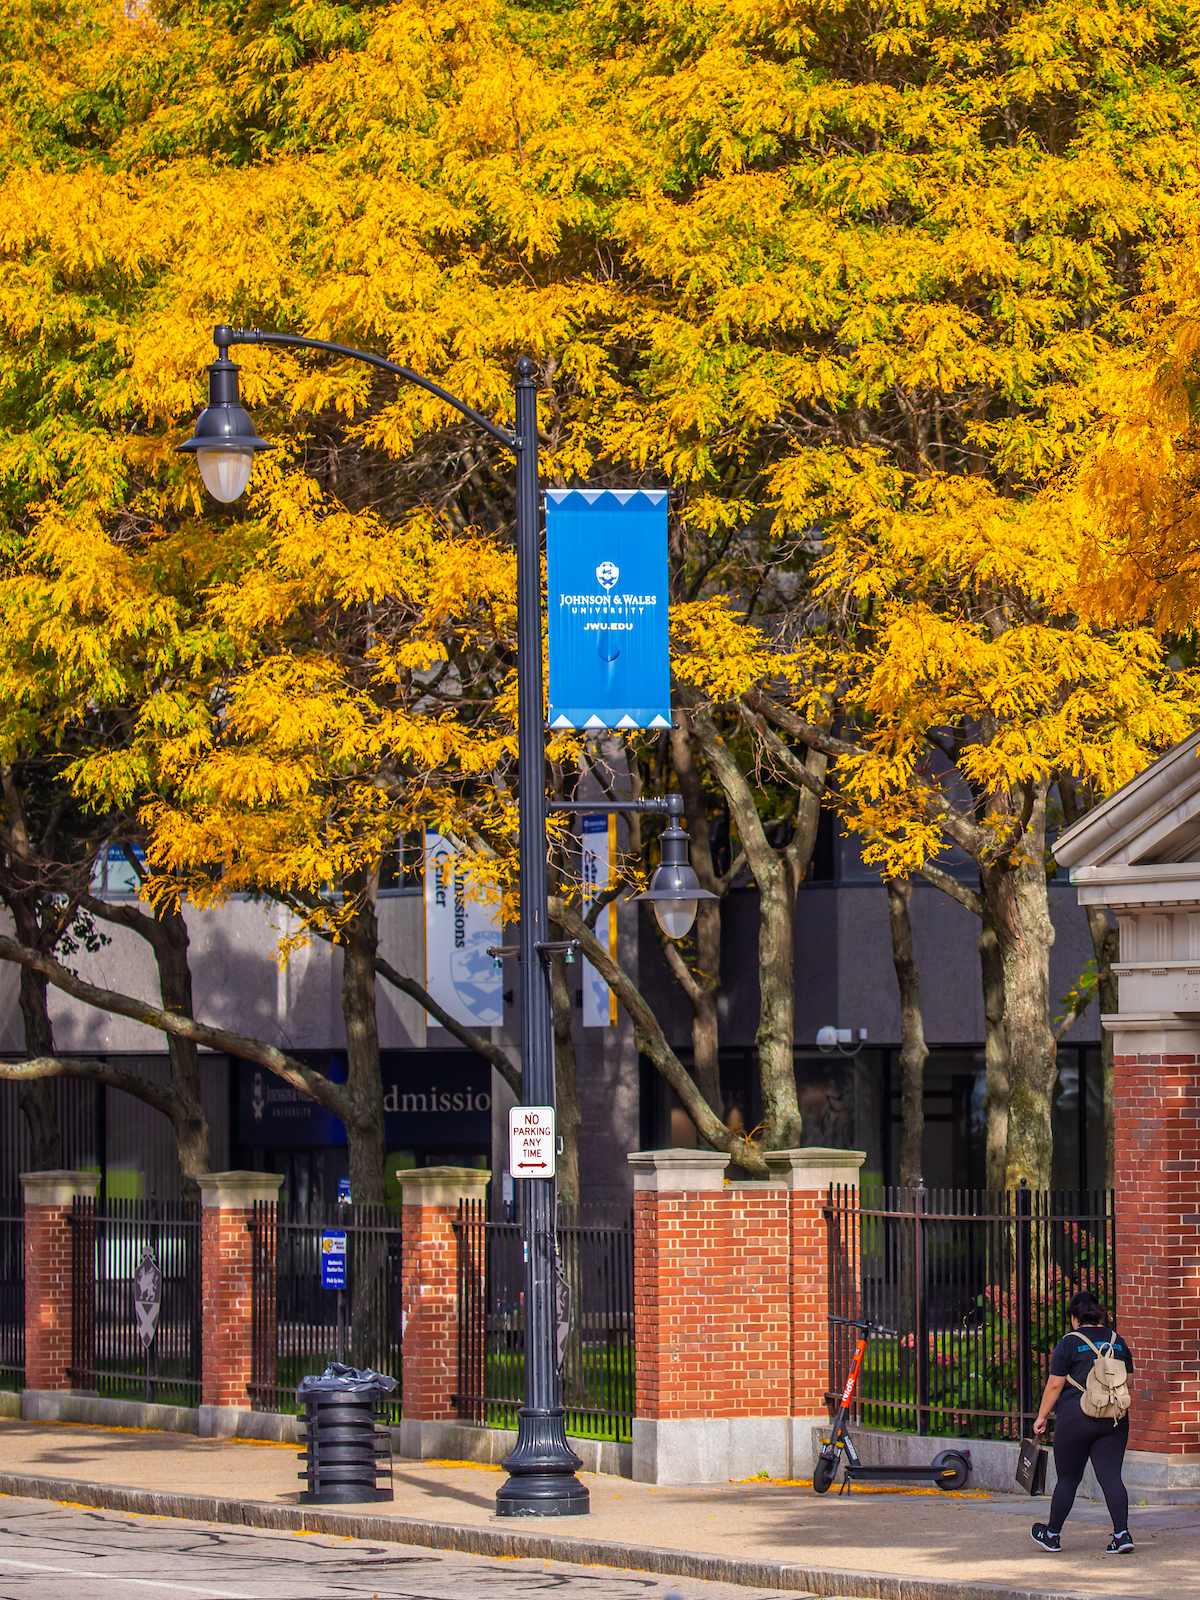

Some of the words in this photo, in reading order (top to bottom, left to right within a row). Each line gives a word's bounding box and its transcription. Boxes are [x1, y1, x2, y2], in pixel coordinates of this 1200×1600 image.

[560, 594, 611, 606] JOHNSON
[613, 595, 622, 605] &
[622, 594, 657, 605] WALES
[524, 1114, 540, 1125] NO
[513, 1127, 551, 1136] PARKING
[523, 1138, 541, 1147] ANY
[523, 1149, 542, 1158] TIME
